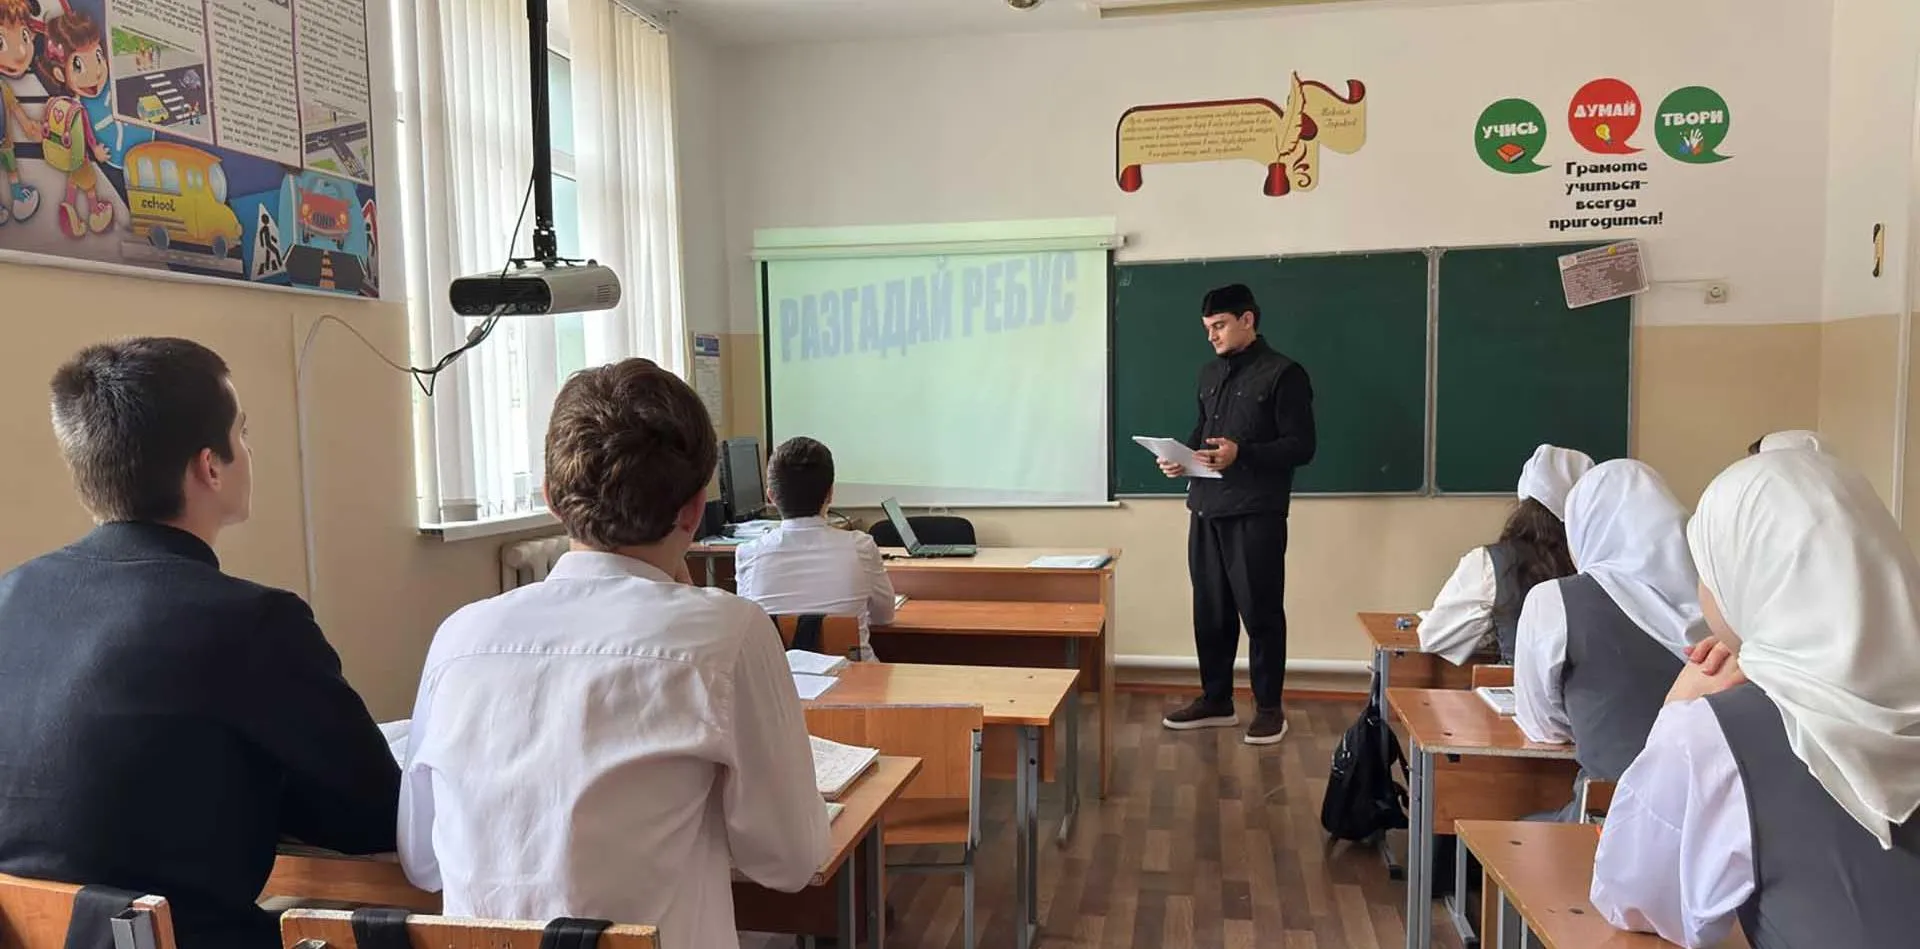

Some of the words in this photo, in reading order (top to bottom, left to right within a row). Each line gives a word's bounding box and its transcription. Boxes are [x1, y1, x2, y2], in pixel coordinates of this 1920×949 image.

[1573, 100, 1636, 118] ДУМАЙ
[1661, 109, 1724, 127] ТВОРИ
[1482, 121, 1539, 140] УЧИСЬ
[1565, 160, 1648, 177] Грамоте
[141, 194, 176, 212] school
[1575, 197, 1637, 212] всегда
[1549, 212, 1664, 231] пригодится!
[779, 254, 953, 362] РАЗГАДАЙ
[961, 251, 1077, 337] РЕБУС
